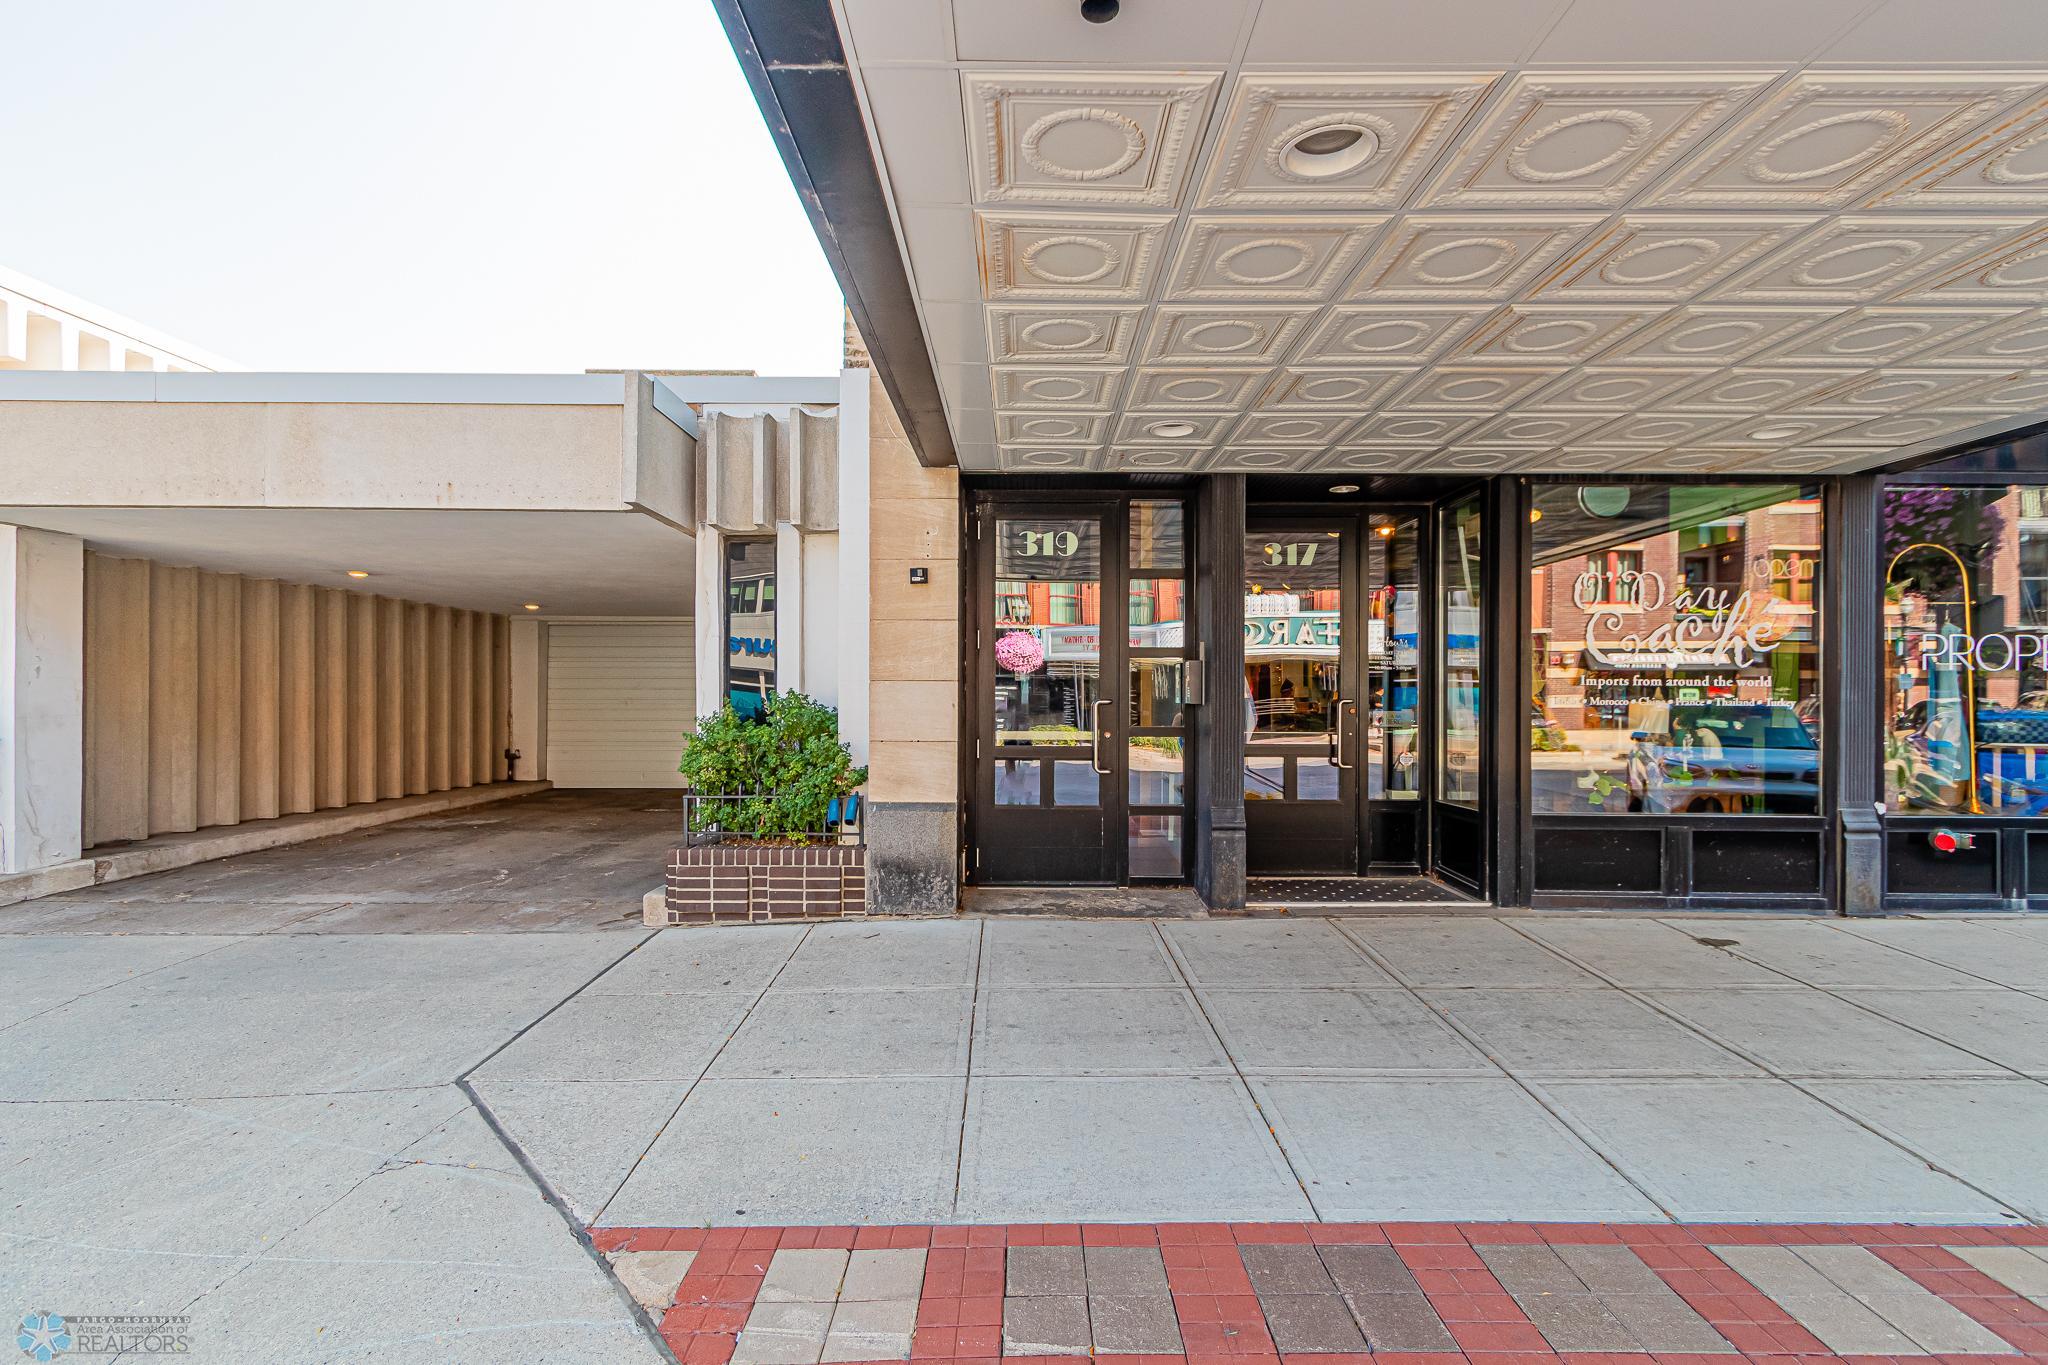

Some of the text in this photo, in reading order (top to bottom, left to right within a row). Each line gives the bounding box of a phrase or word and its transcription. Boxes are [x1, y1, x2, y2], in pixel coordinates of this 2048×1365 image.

[1016, 530, 1079, 557] 319
[1262, 542, 1319, 566] 317
[1753, 558, 1814, 584] open
[1580, 675, 1772, 689] Imports from around the world
[1589, 697, 1629, 706] Morocco
[1675, 697, 1705, 706] France
[1714, 697, 1755, 707] Thailand
[1766, 697, 1797, 710] Turkey
